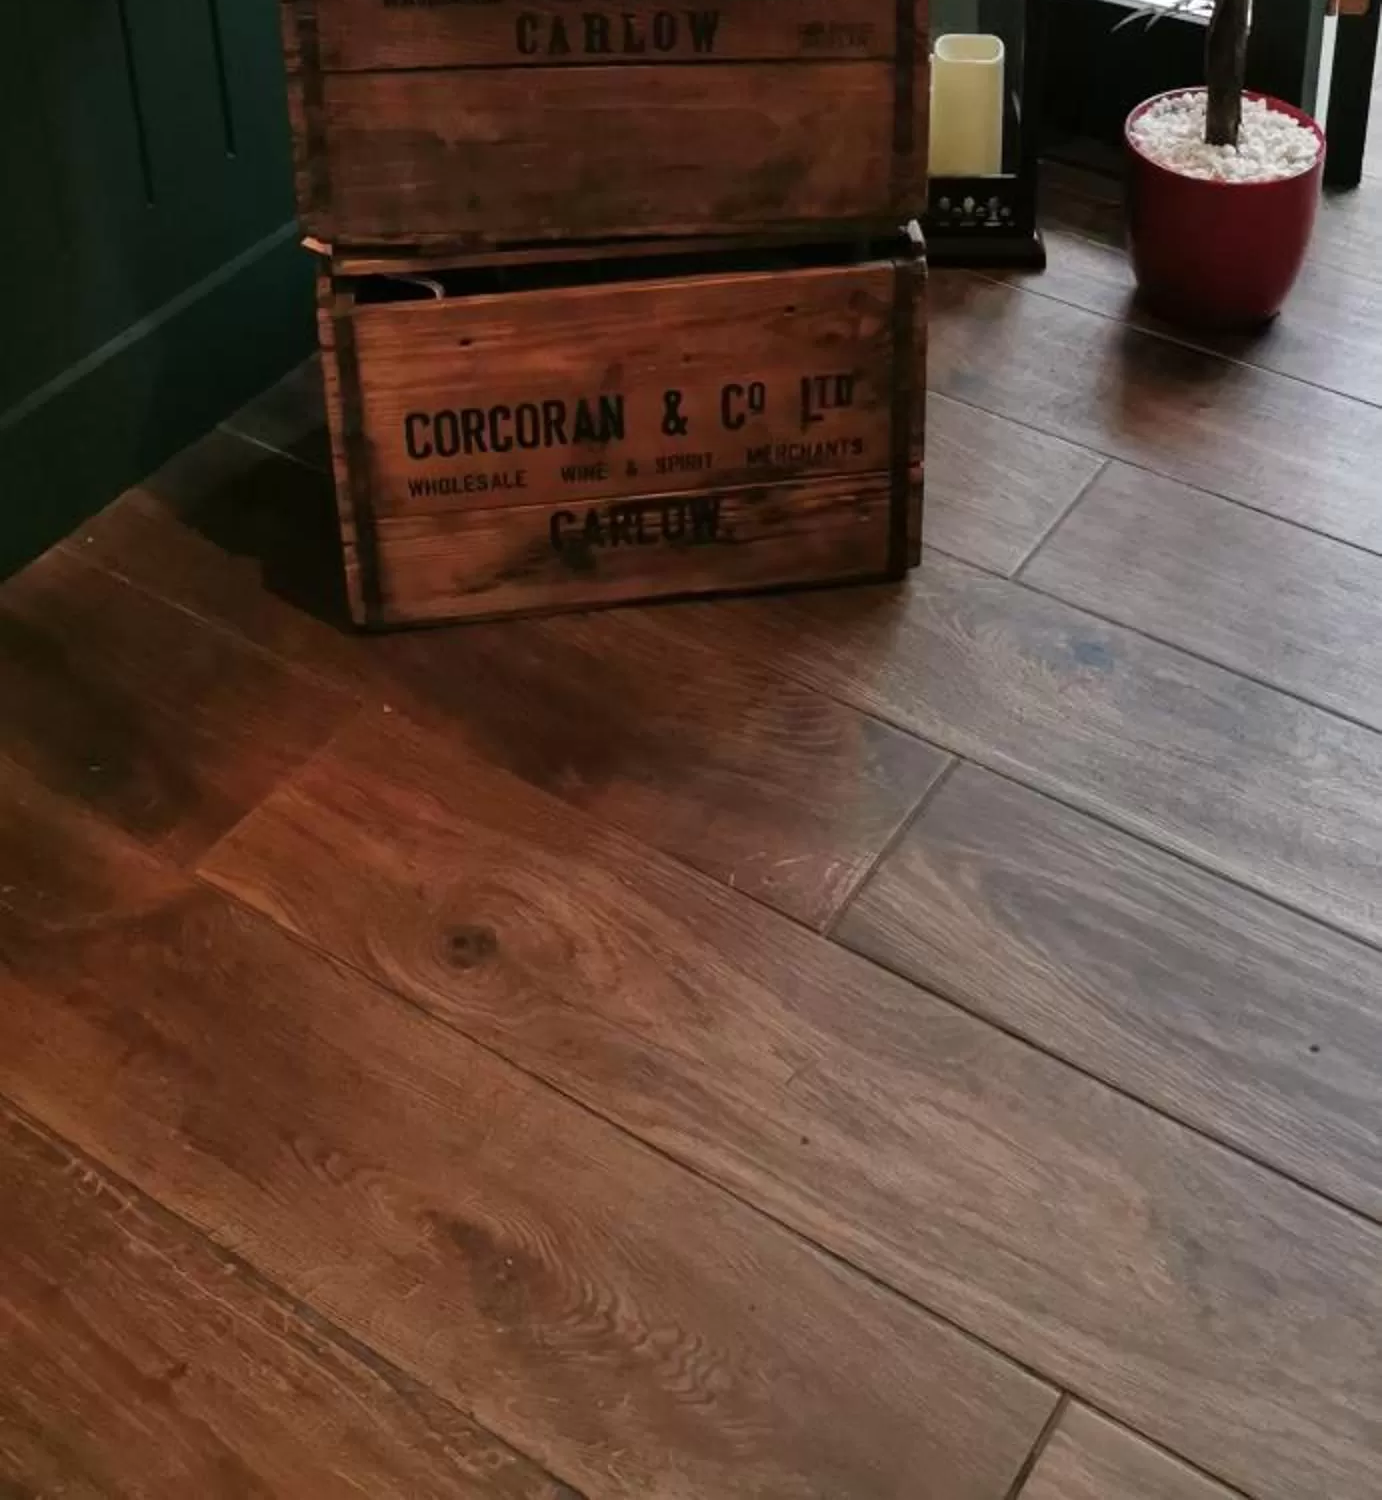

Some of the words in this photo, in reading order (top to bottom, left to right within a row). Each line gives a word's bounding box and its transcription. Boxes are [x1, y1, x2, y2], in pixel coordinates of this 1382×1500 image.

[515, 9, 721, 55] CARLOW
[404, 394, 625, 461] CORCORAN
[661, 389, 688, 437] &
[408, 470, 528, 498] WHOLESALE
[560, 463, 609, 484] WINE
[625, 458, 639, 478] &
[655, 451, 714, 475] SPIRIT
[746, 437, 864, 466] MERCHANTS
